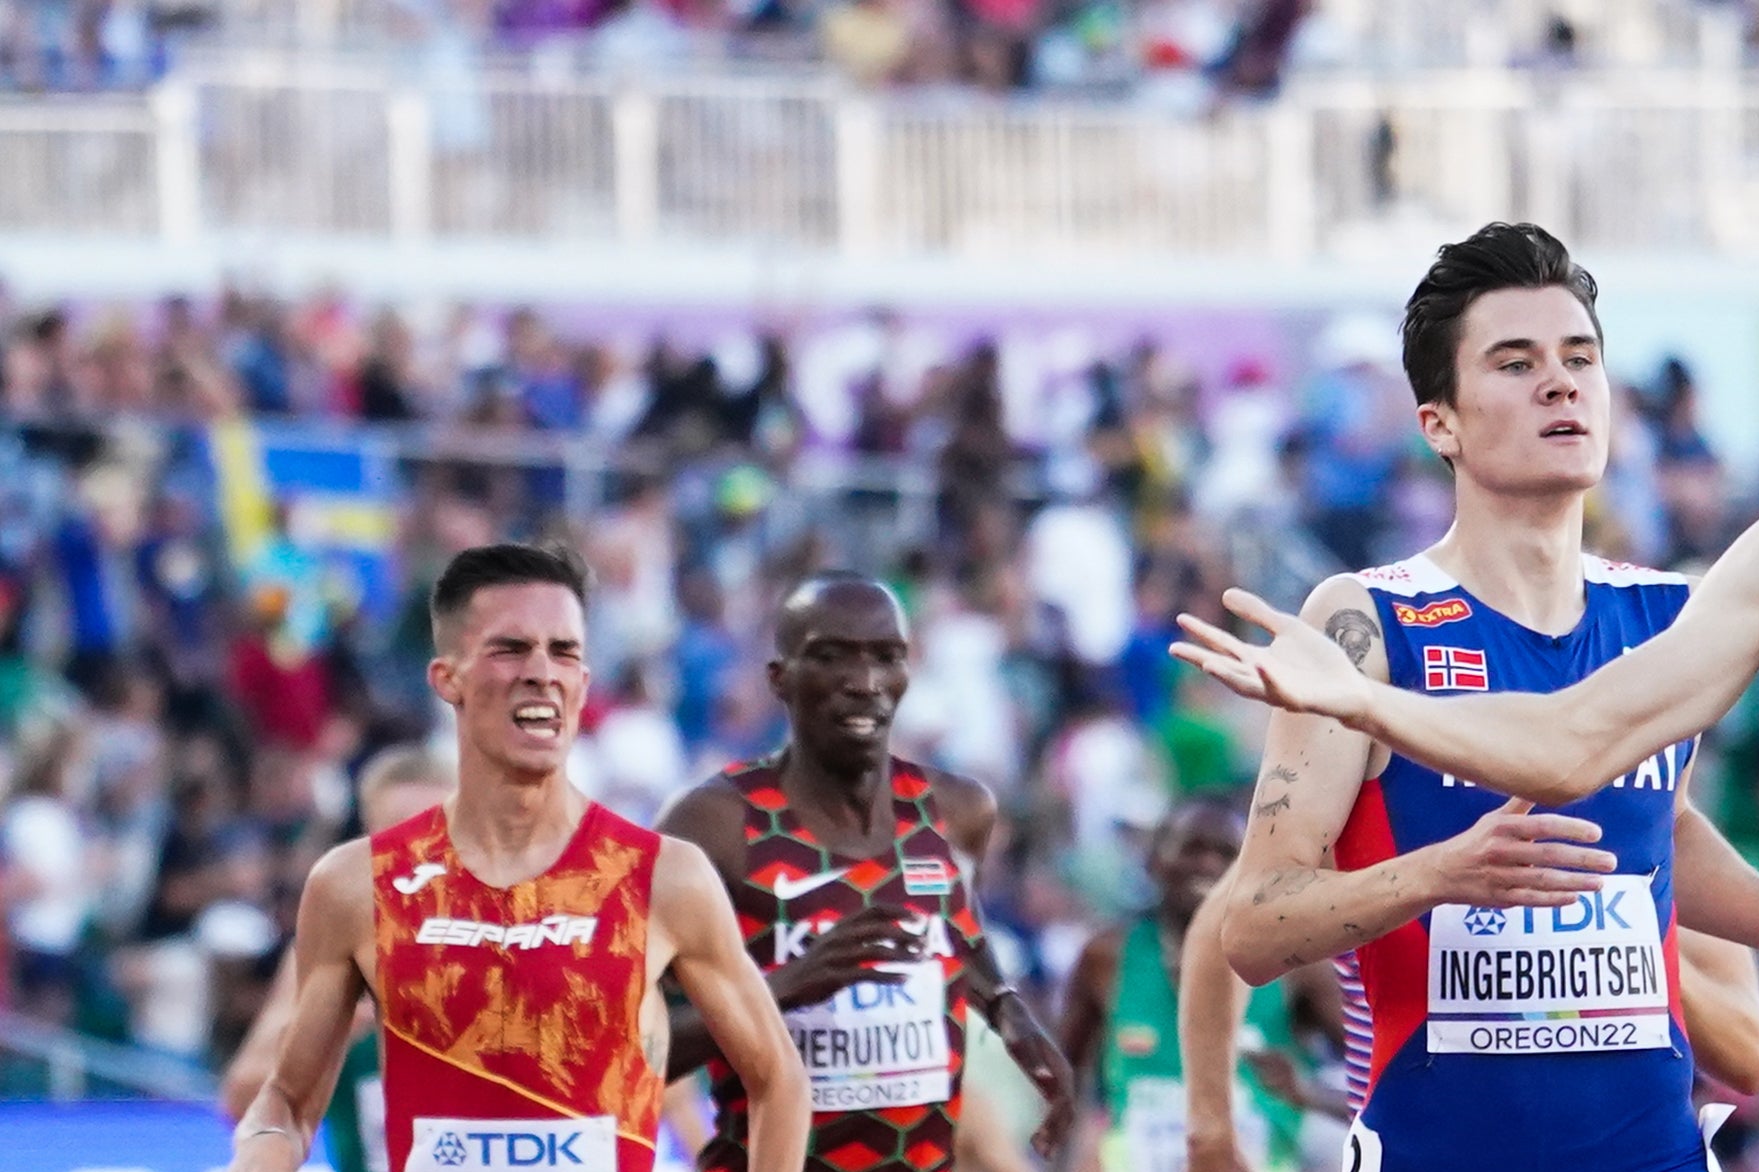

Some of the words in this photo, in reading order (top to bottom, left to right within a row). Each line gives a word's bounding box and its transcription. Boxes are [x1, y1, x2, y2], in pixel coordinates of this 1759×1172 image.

[415, 914, 599, 951] ESPAÑA
[1439, 945, 1658, 1001] INGEBRIGTSEN
[828, 978, 914, 1013] DK
[789, 1018, 935, 1070] HERUIYOT
[1470, 1022, 1638, 1050] OREGON22
[811, 1080, 921, 1107] REGON22
[466, 1131, 584, 1167] TDK
